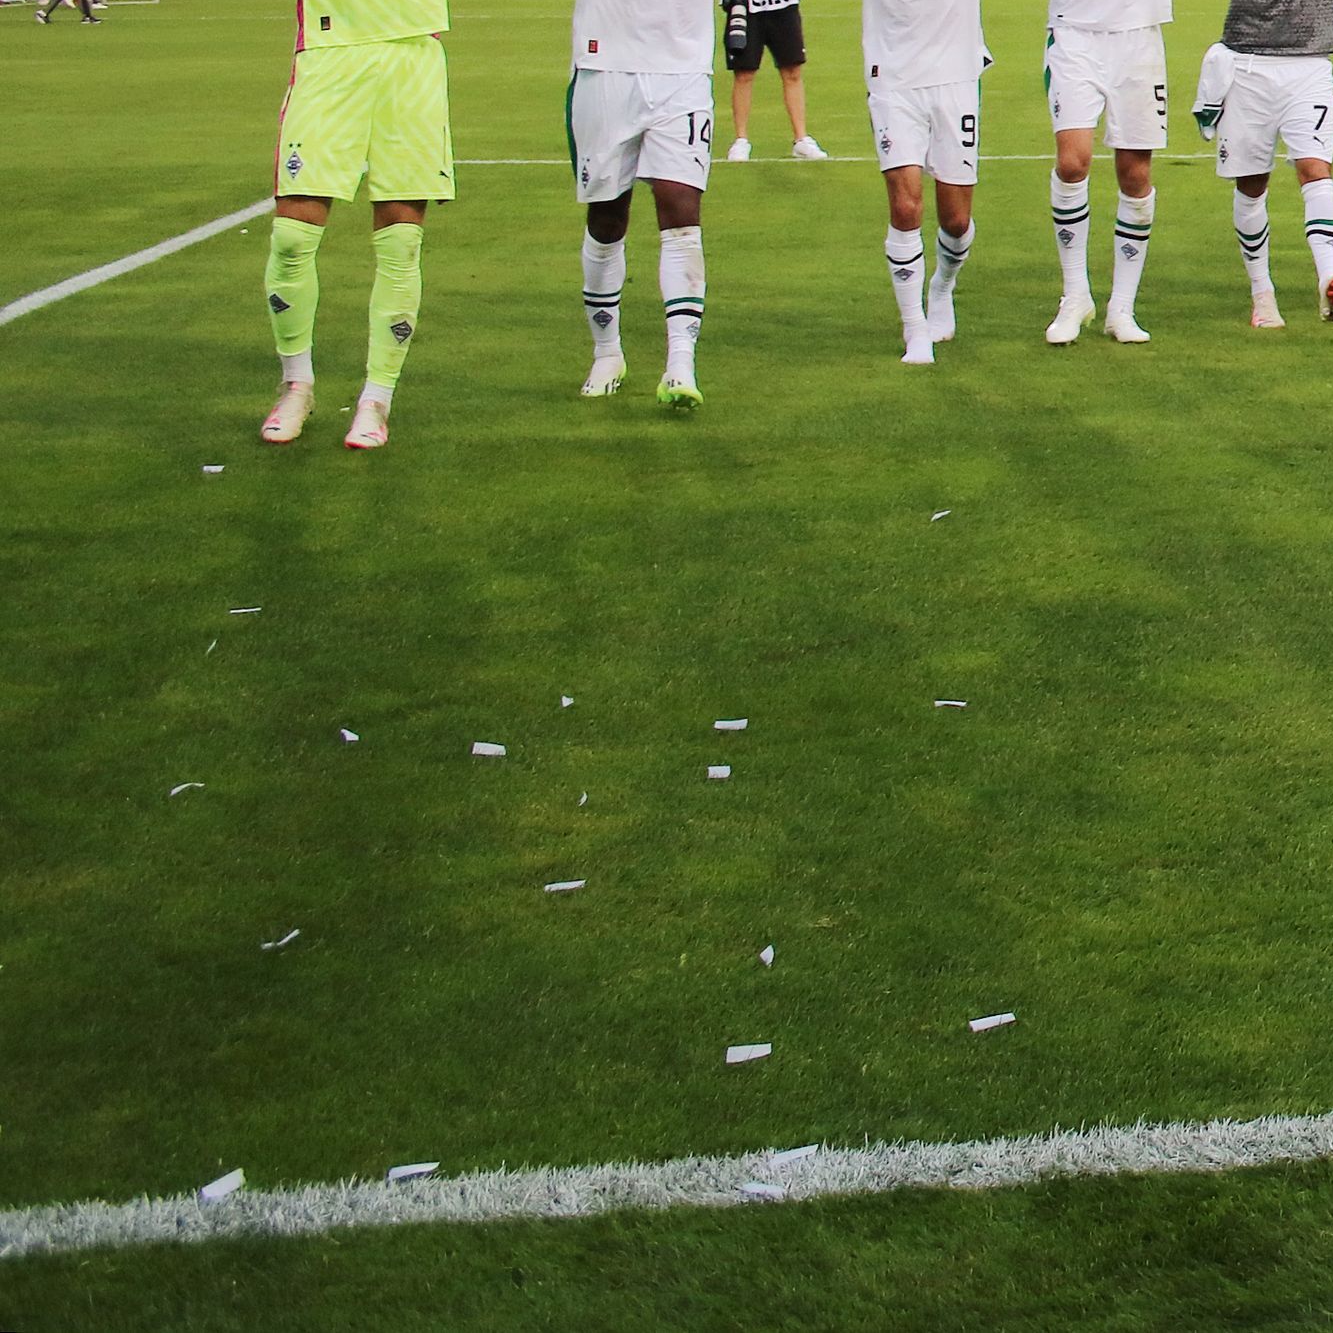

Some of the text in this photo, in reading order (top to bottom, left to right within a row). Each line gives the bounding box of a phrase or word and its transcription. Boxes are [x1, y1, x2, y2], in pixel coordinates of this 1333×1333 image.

[687, 112, 711, 153] 14
[960, 114, 977, 148] 9
[1313, 104, 1328, 131] 7
